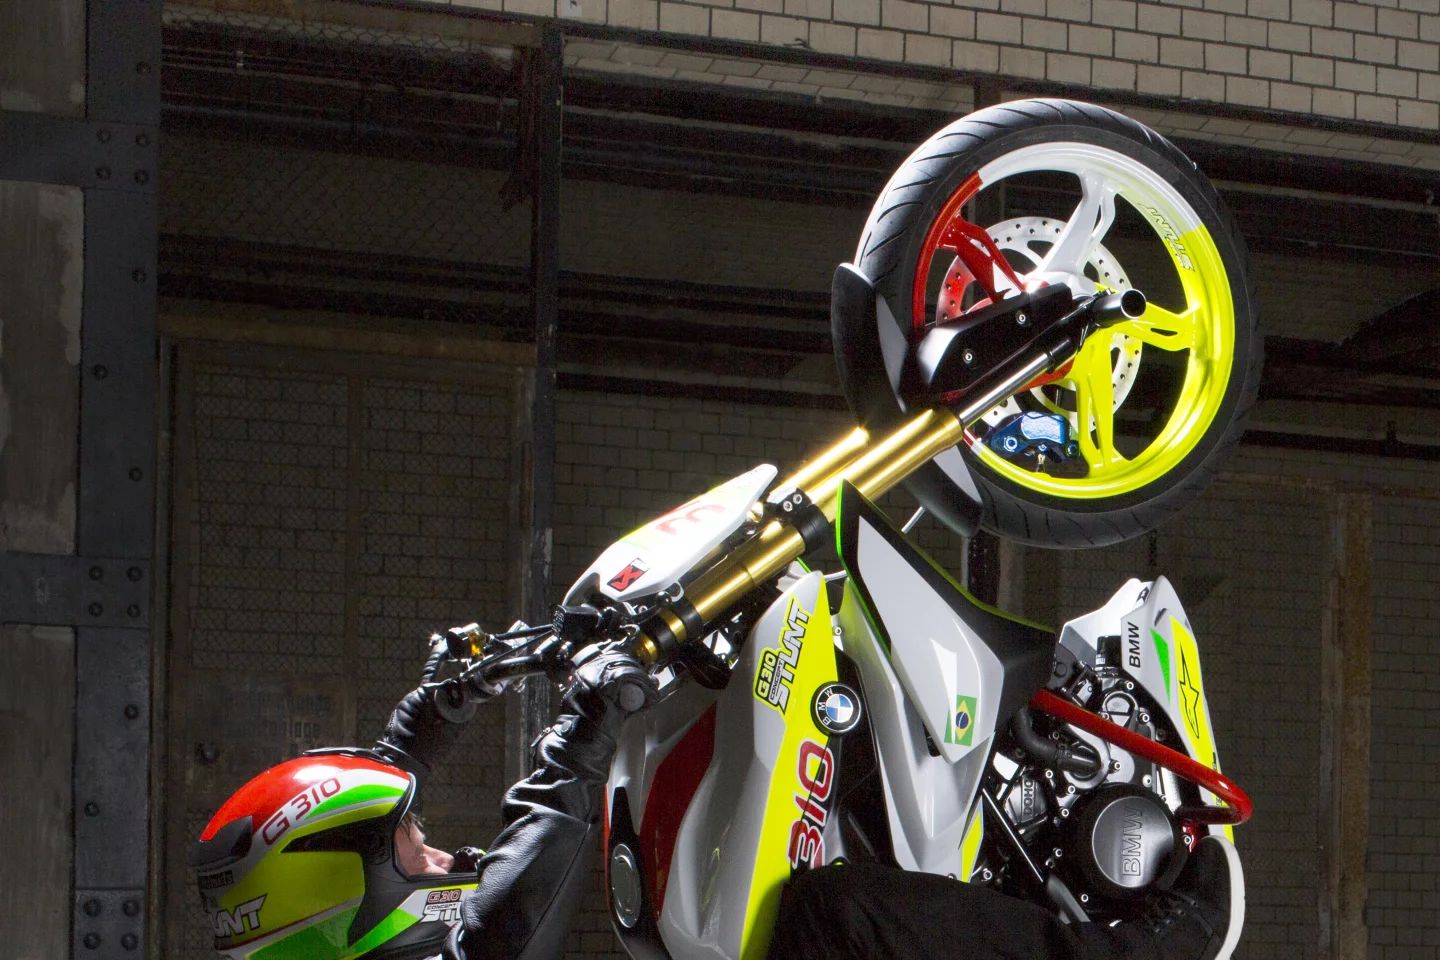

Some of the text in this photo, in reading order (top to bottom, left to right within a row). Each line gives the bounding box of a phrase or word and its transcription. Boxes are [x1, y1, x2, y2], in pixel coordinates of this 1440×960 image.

[777, 598, 809, 715] STUNT
[1128, 621, 1141, 668] BMW
[758, 653, 777, 698] G310
[770, 661, 784, 700] CONCEPT
[787, 739, 834, 869] 310
[1122, 806, 1144, 877] BMW
